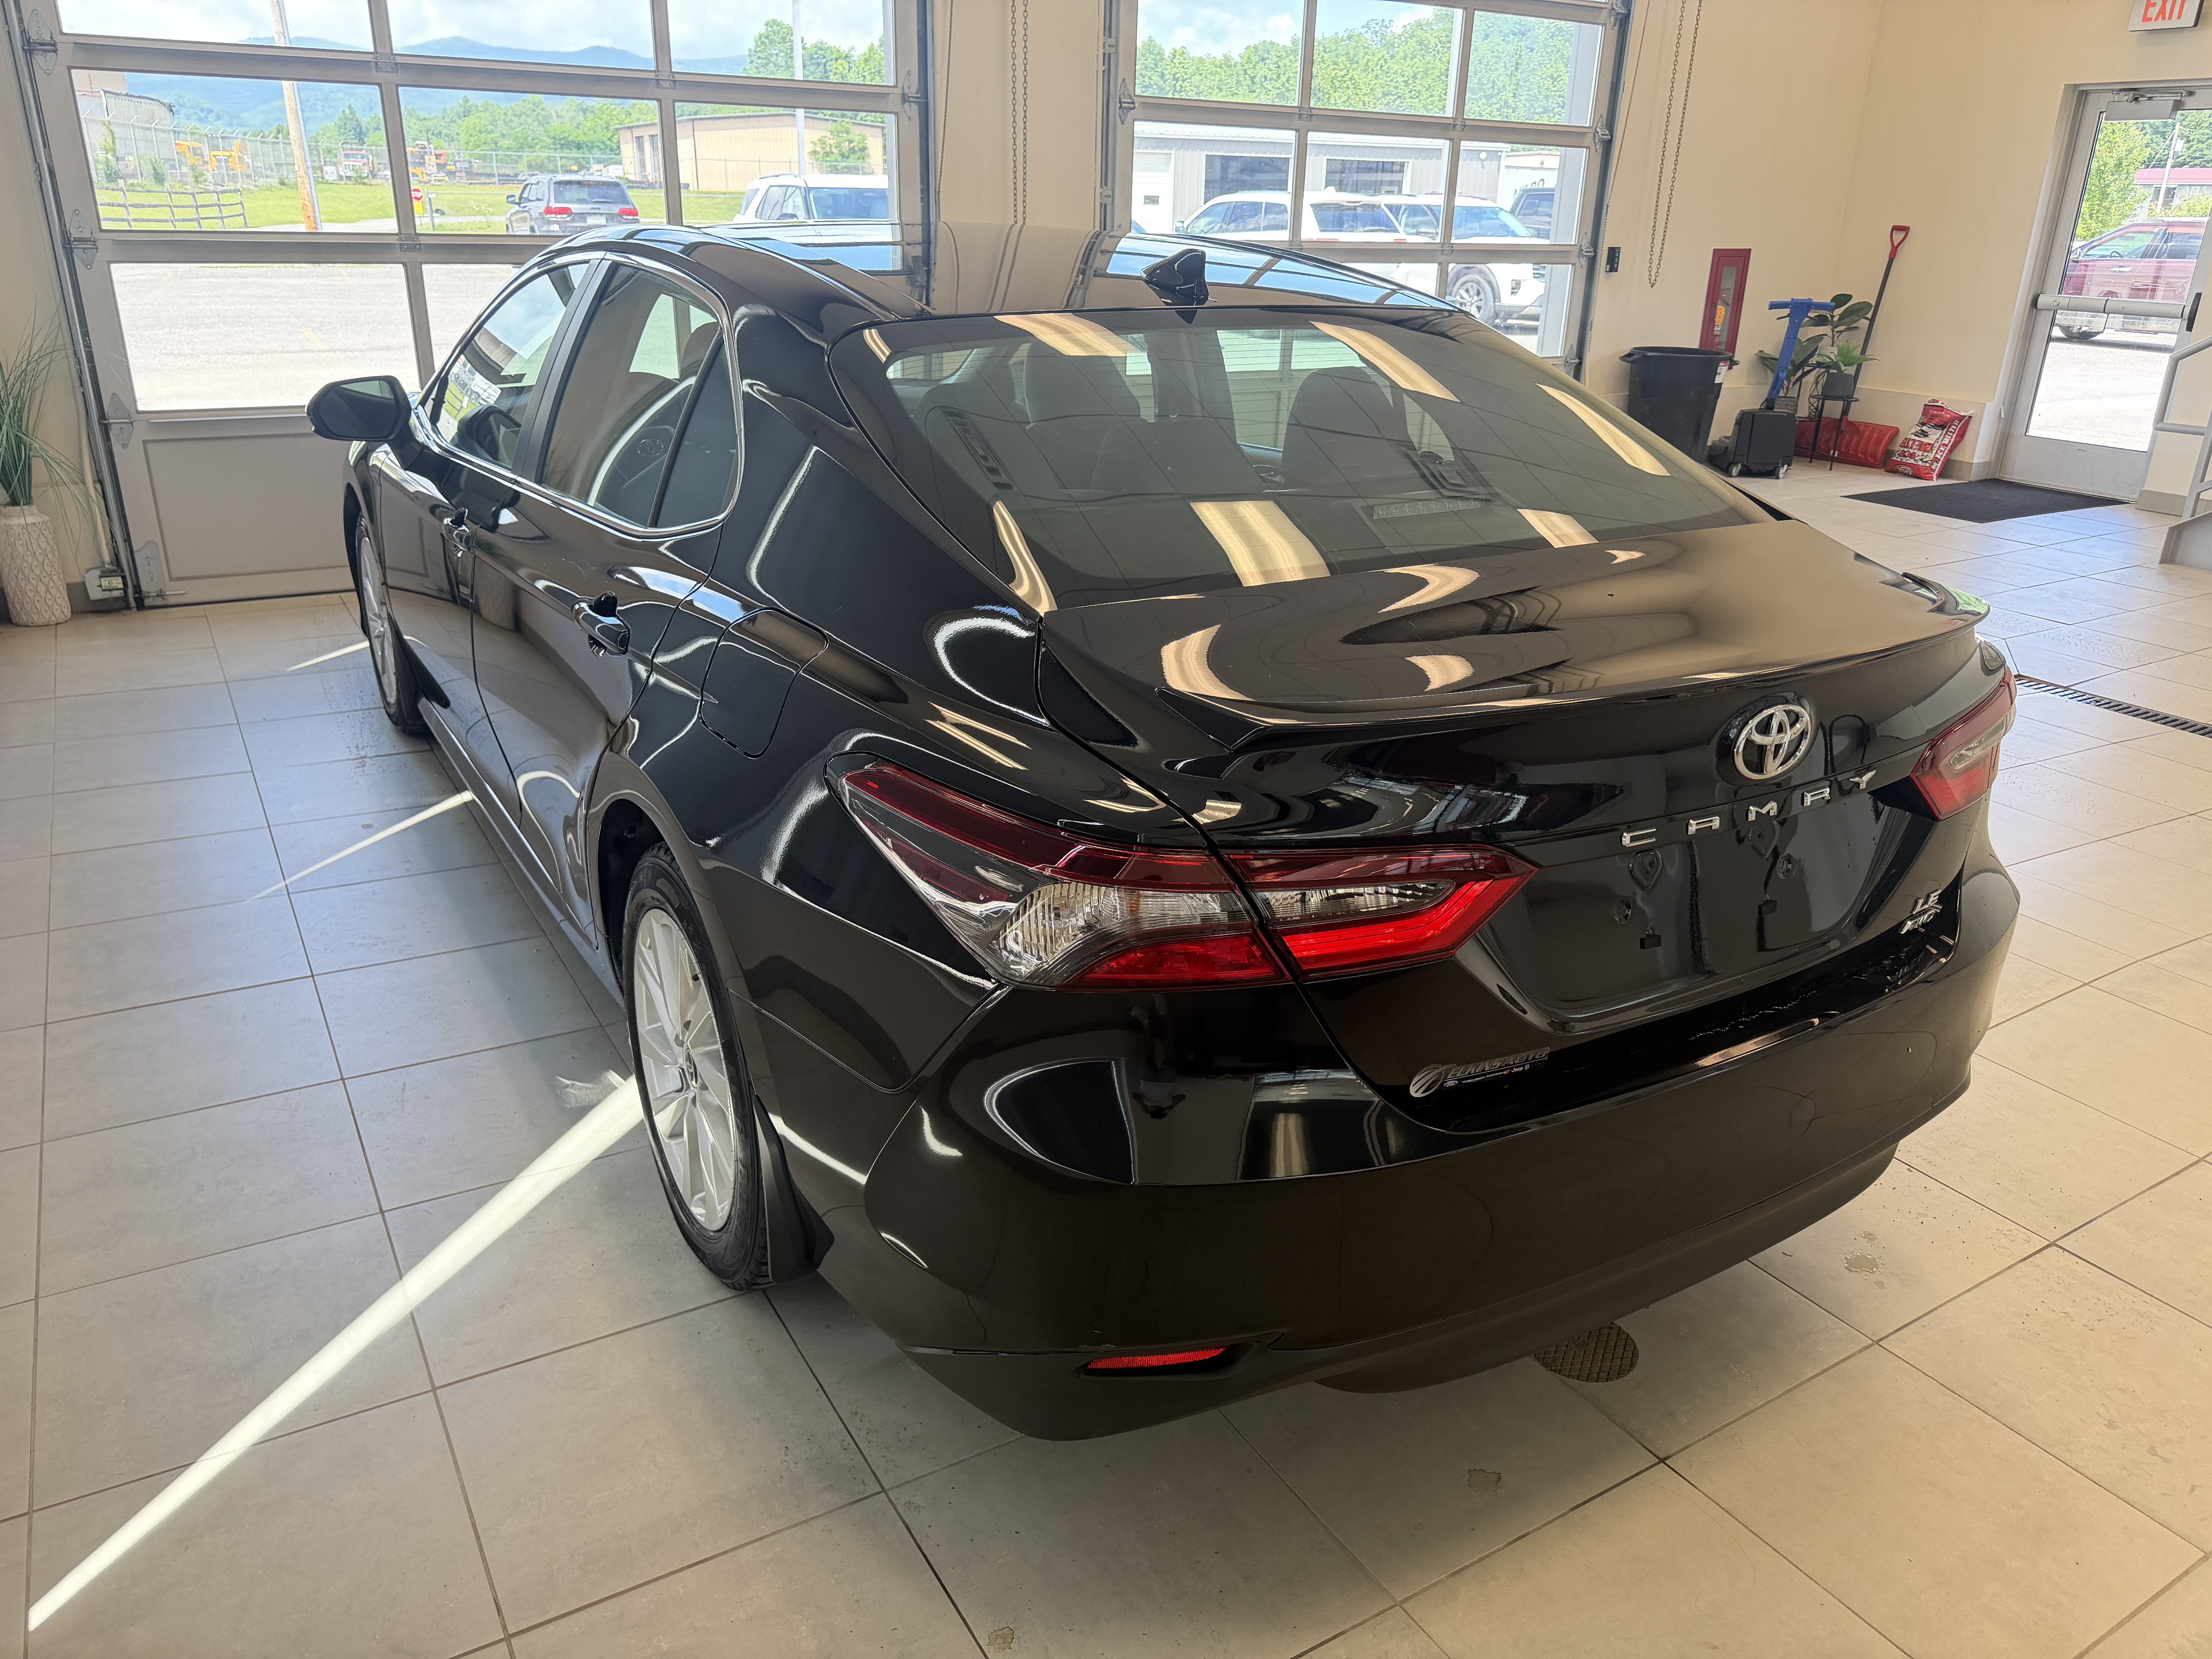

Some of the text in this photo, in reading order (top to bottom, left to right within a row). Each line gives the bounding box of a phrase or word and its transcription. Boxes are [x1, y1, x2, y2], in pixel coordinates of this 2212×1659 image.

[2142, 0, 2186, 22] EXIT
[1943, 419, 1960, 445] MELTER
[1621, 769, 1877, 848] CAMRY
[1911, 890, 1942, 915] LE
